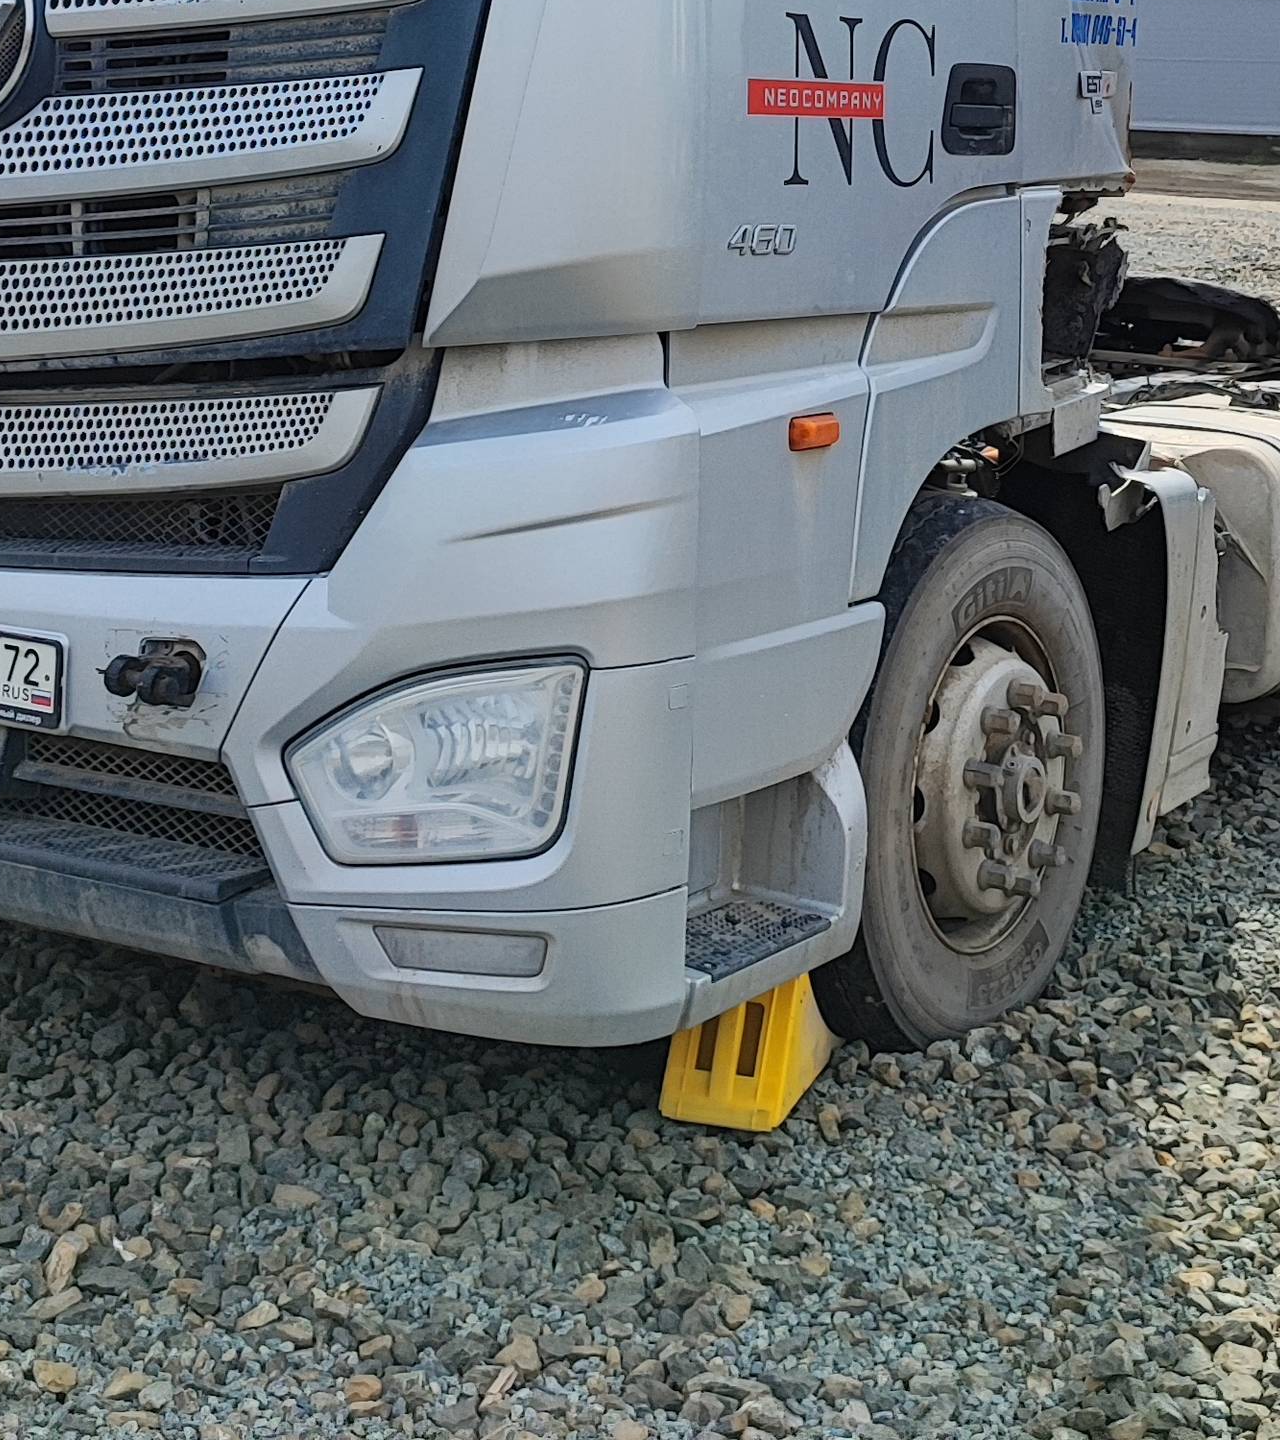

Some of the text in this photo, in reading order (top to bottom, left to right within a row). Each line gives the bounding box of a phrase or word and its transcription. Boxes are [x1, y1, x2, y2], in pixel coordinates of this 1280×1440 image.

[764, 86, 882, 111] NEOCOMPANY
[784, 12, 936, 188] NC
[727, 223, 797, 257] 460
[4, 643, 40, 687] 72
[2, 683, 30, 702] RUS
